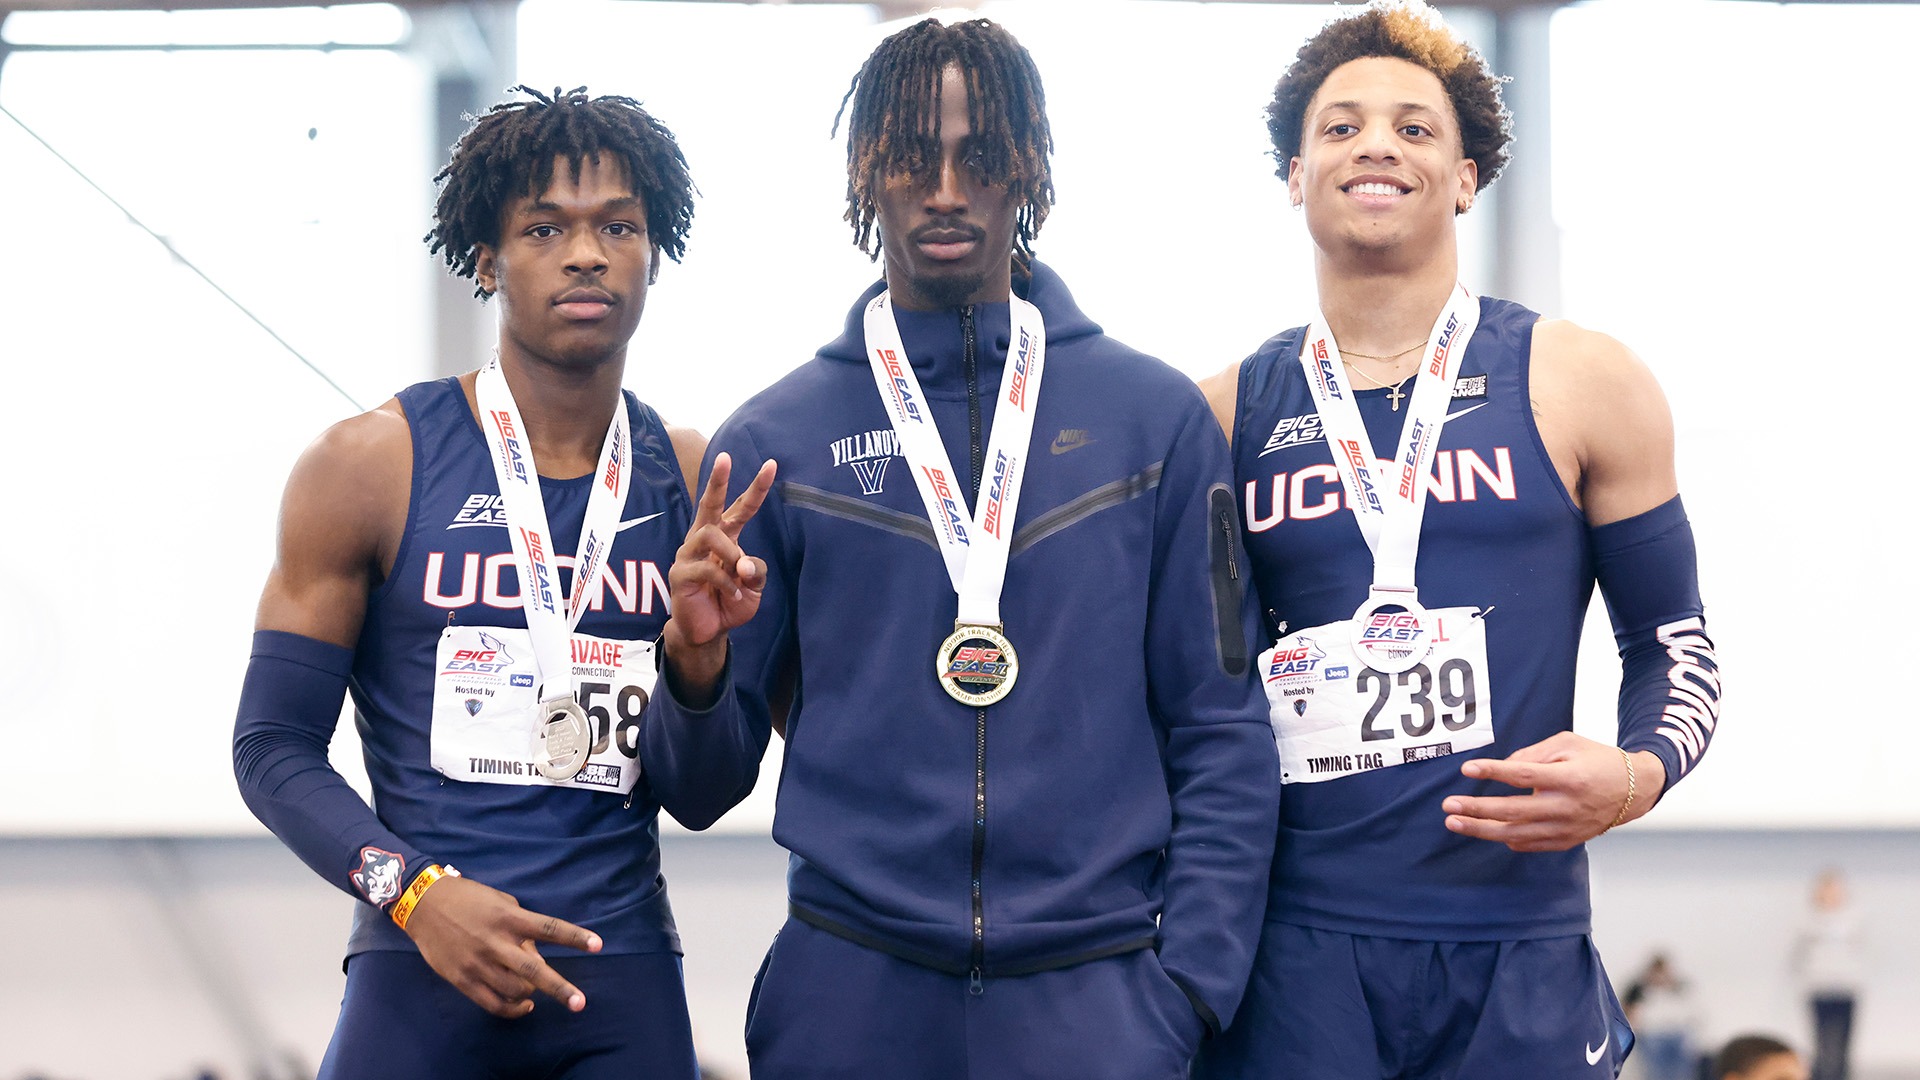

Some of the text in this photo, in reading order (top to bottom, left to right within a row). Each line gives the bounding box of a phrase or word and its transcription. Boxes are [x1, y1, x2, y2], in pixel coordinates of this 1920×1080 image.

[1452, 387, 1485, 397] ANGE
[1272, 414, 1321, 434] BIG
[1057, 429, 1088, 443] NIKE
[830, 430, 904, 466] VILLANOV
[850, 457, 891, 494] V
[1246, 447, 1516, 532] UCNN
[453, 508, 507, 522] EA
[424, 552, 672, 614] UCNN
[1371, 615, 1413, 627] BIG
[1363, 627, 1424, 640] EAST
[944, 632, 966, 652] NDOOR
[968, 630, 991, 638] TRACK
[999, 637, 1013, 656] FIELD
[453, 650, 497, 662] BIG
[570, 639, 623, 667] AVAGE
[957, 648, 1001, 662] BIG
[1272, 647, 1309, 664] BIG
[445, 661, 508, 673] EAST
[572, 667, 615, 678] CONNECTICUT
[950, 661, 1009, 674] EAST
[1269, 659, 1320, 676] EAST
[1327, 669, 1346, 678] Jeep
[513, 676, 531, 685] Jeep
[455, 686, 495, 697] Hosted by
[948, 683, 1006, 702] CHAMPIONSHIPS
[1284, 686, 1314, 696] Hosted by
[1656, 616, 1721, 775] UCONN
[1357, 658, 1476, 742] 239
[538, 682, 649, 758] 58
[469, 758, 522, 775] TIMING
[1307, 752, 1384, 774] TIMING TAG
[577, 774, 618, 786] CHANGE
